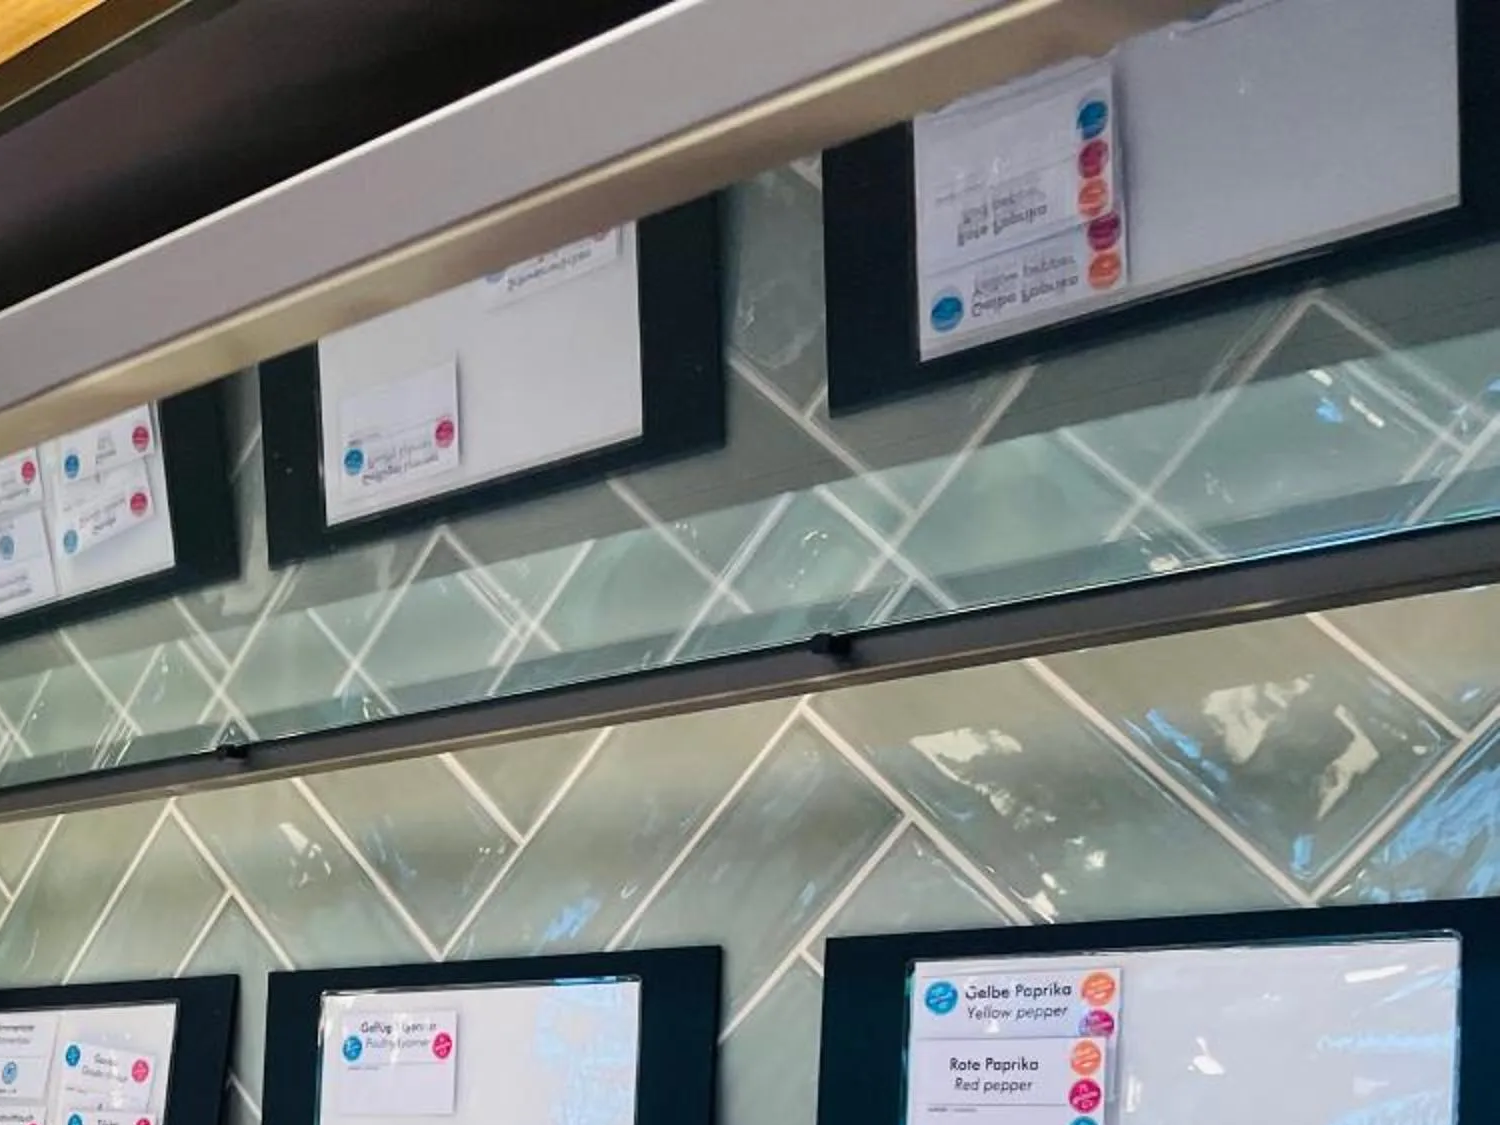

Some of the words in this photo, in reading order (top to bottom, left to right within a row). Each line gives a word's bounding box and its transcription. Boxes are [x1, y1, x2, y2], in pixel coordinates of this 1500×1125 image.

[1014, 982, 1073, 1000] Paprika
[967, 1006, 1011, 1020] Yellow
[1015, 1005, 1069, 1020] pepper
[950, 1057, 981, 1071] Rote
[985, 1055, 1040, 1074] Paprika
[954, 1077, 980, 1091] Red
[982, 1078, 1033, 1094] pepper
